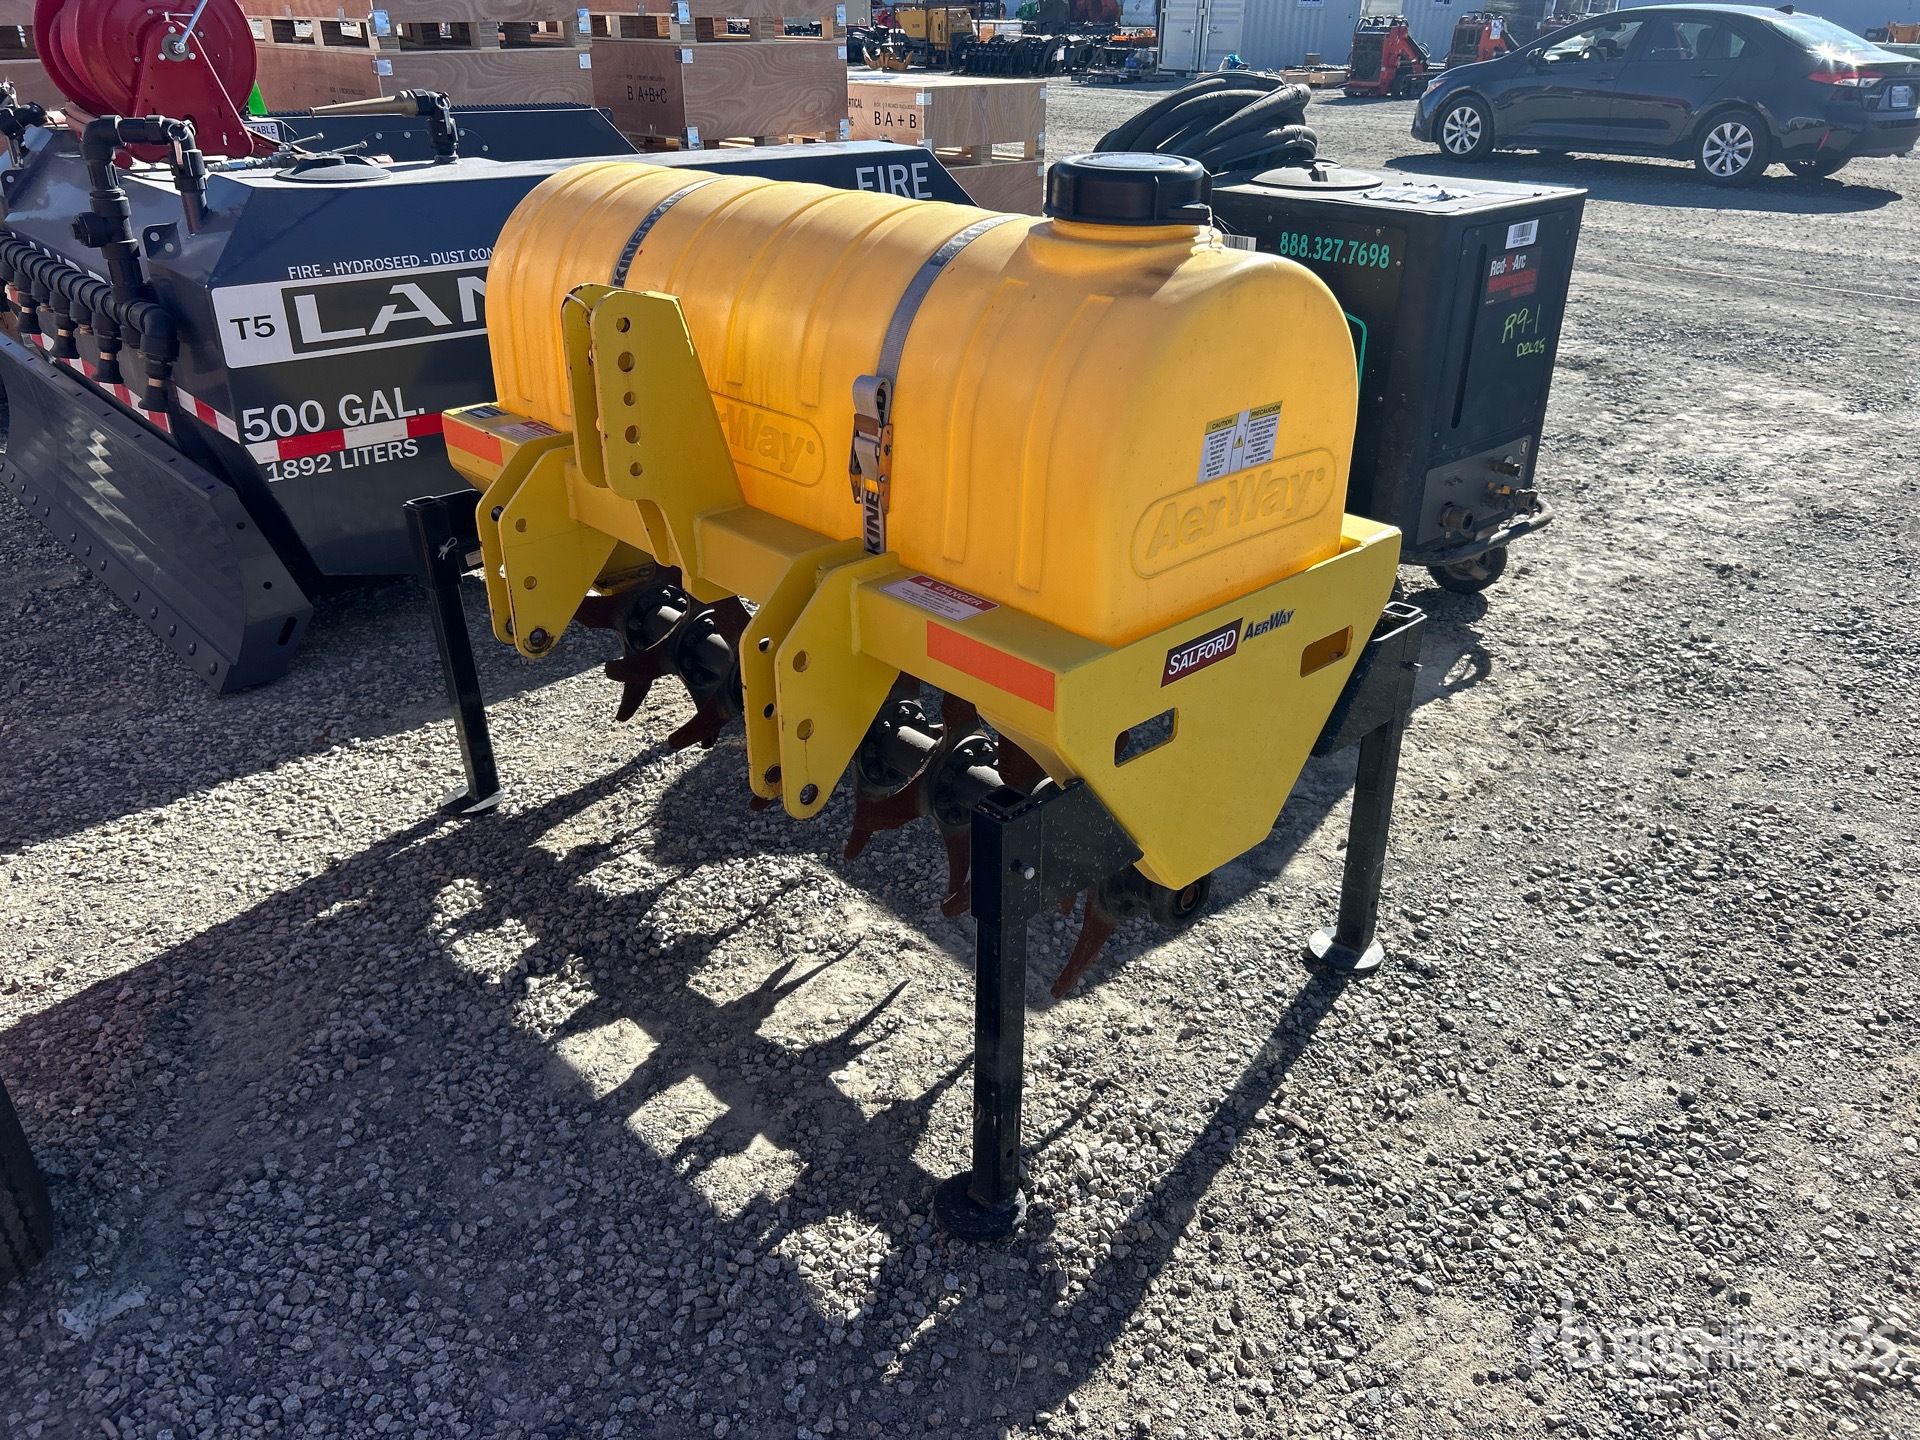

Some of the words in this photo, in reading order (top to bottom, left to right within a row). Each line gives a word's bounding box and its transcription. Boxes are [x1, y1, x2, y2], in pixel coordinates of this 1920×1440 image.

[874, 111, 882, 126] B
[909, 114, 917, 129] B
[855, 161, 933, 199] FIRE
[288, 264, 323, 280] FIRE
[333, 255, 420, 275] HYDROSEED
[431, 250, 465, 265] DUST
[1279, 231, 1390, 269] 888.327.7698
[229, 315, 276, 340] T5
[242, 400, 326, 442] 500
[338, 387, 426, 427] GAL.
[1211, 418, 1233, 429] CAUTION
[266, 454, 333, 483] 1892
[339, 439, 419, 470] LITERS
[934, 586, 984, 607] DANGER
[1168, 629, 1237, 676] SALFORD
